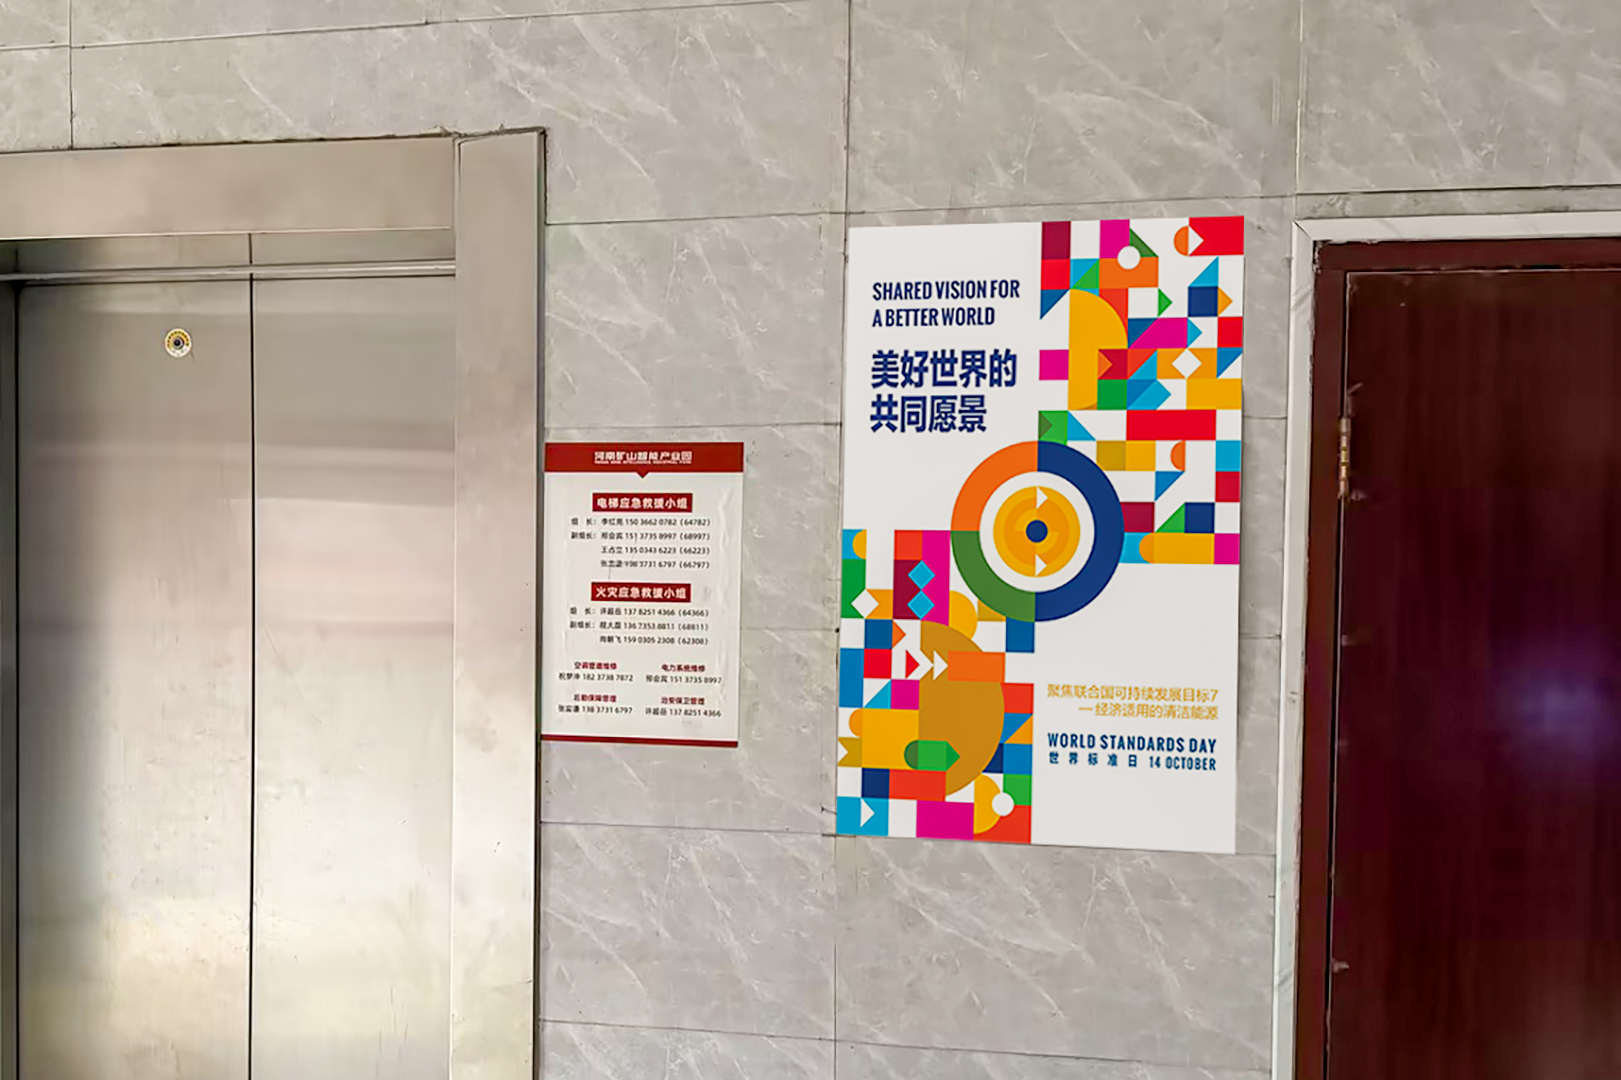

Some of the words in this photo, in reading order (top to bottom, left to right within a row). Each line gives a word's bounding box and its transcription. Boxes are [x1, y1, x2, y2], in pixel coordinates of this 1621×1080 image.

[872, 281, 932, 301] SHARED
[936, 280, 986, 299] VISION
[990, 279, 1020, 298] FOR
[872, 309, 882, 327] A
[885, 308, 938, 326] BETTER
[941, 307, 995, 326] WORLD
[871, 348, 1017, 388] 美好世界的
[870, 394, 987, 433] 共同愿景
[597, 498, 688, 509] 电梯应急救援小组
[625, 518, 638, 526] 150
[640, 518, 657, 526] 3662
[596, 587, 686, 598] 火灾应急救援小组
[624, 608, 637, 616] 137
[638, 608, 656, 616] 8251
[658, 608, 675, 616] 4366
[624, 622, 636, 630] 136
[686, 676, 704, 684] 3735
[1047, 684, 1219, 702] 聚焦联合国可持续发展目标7
[615, 706, 633, 714] 6797
[670, 708, 683, 716] 137
[704, 709, 721, 717] 4366
[1047, 732, 1096, 748] WORLD
[1100, 734, 1185, 752] STANDARDS
[1189, 738, 1217, 753] DAY
[1149, 756, 1161, 768] 14
[1165, 756, 1216, 771] OCTOBER
